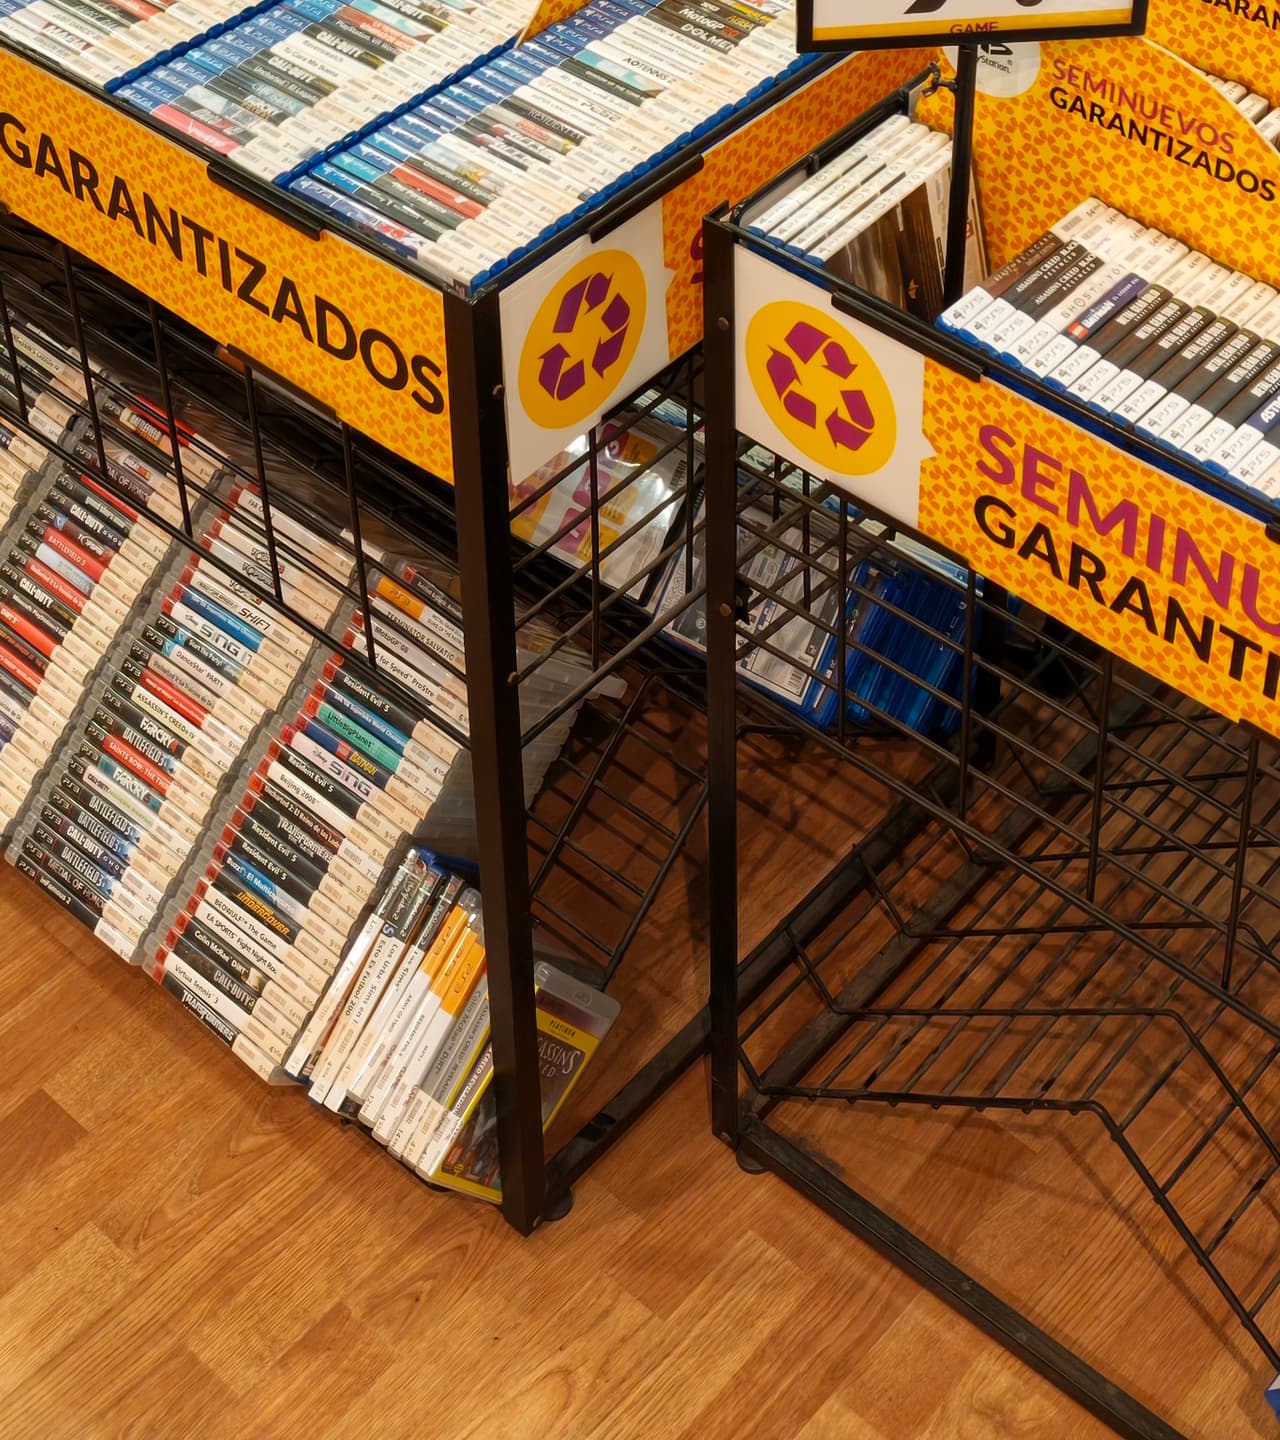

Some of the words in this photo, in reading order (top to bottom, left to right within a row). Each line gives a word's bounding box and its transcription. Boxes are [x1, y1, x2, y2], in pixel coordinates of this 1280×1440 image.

[949, 21, 999, 35] GAME
[1049, 85, 1277, 203] GARANTIZADOS
[1051, 58, 1237, 158] SEMINUEVOS
[182, 990, 235, 1042] TRANSFORMERS
